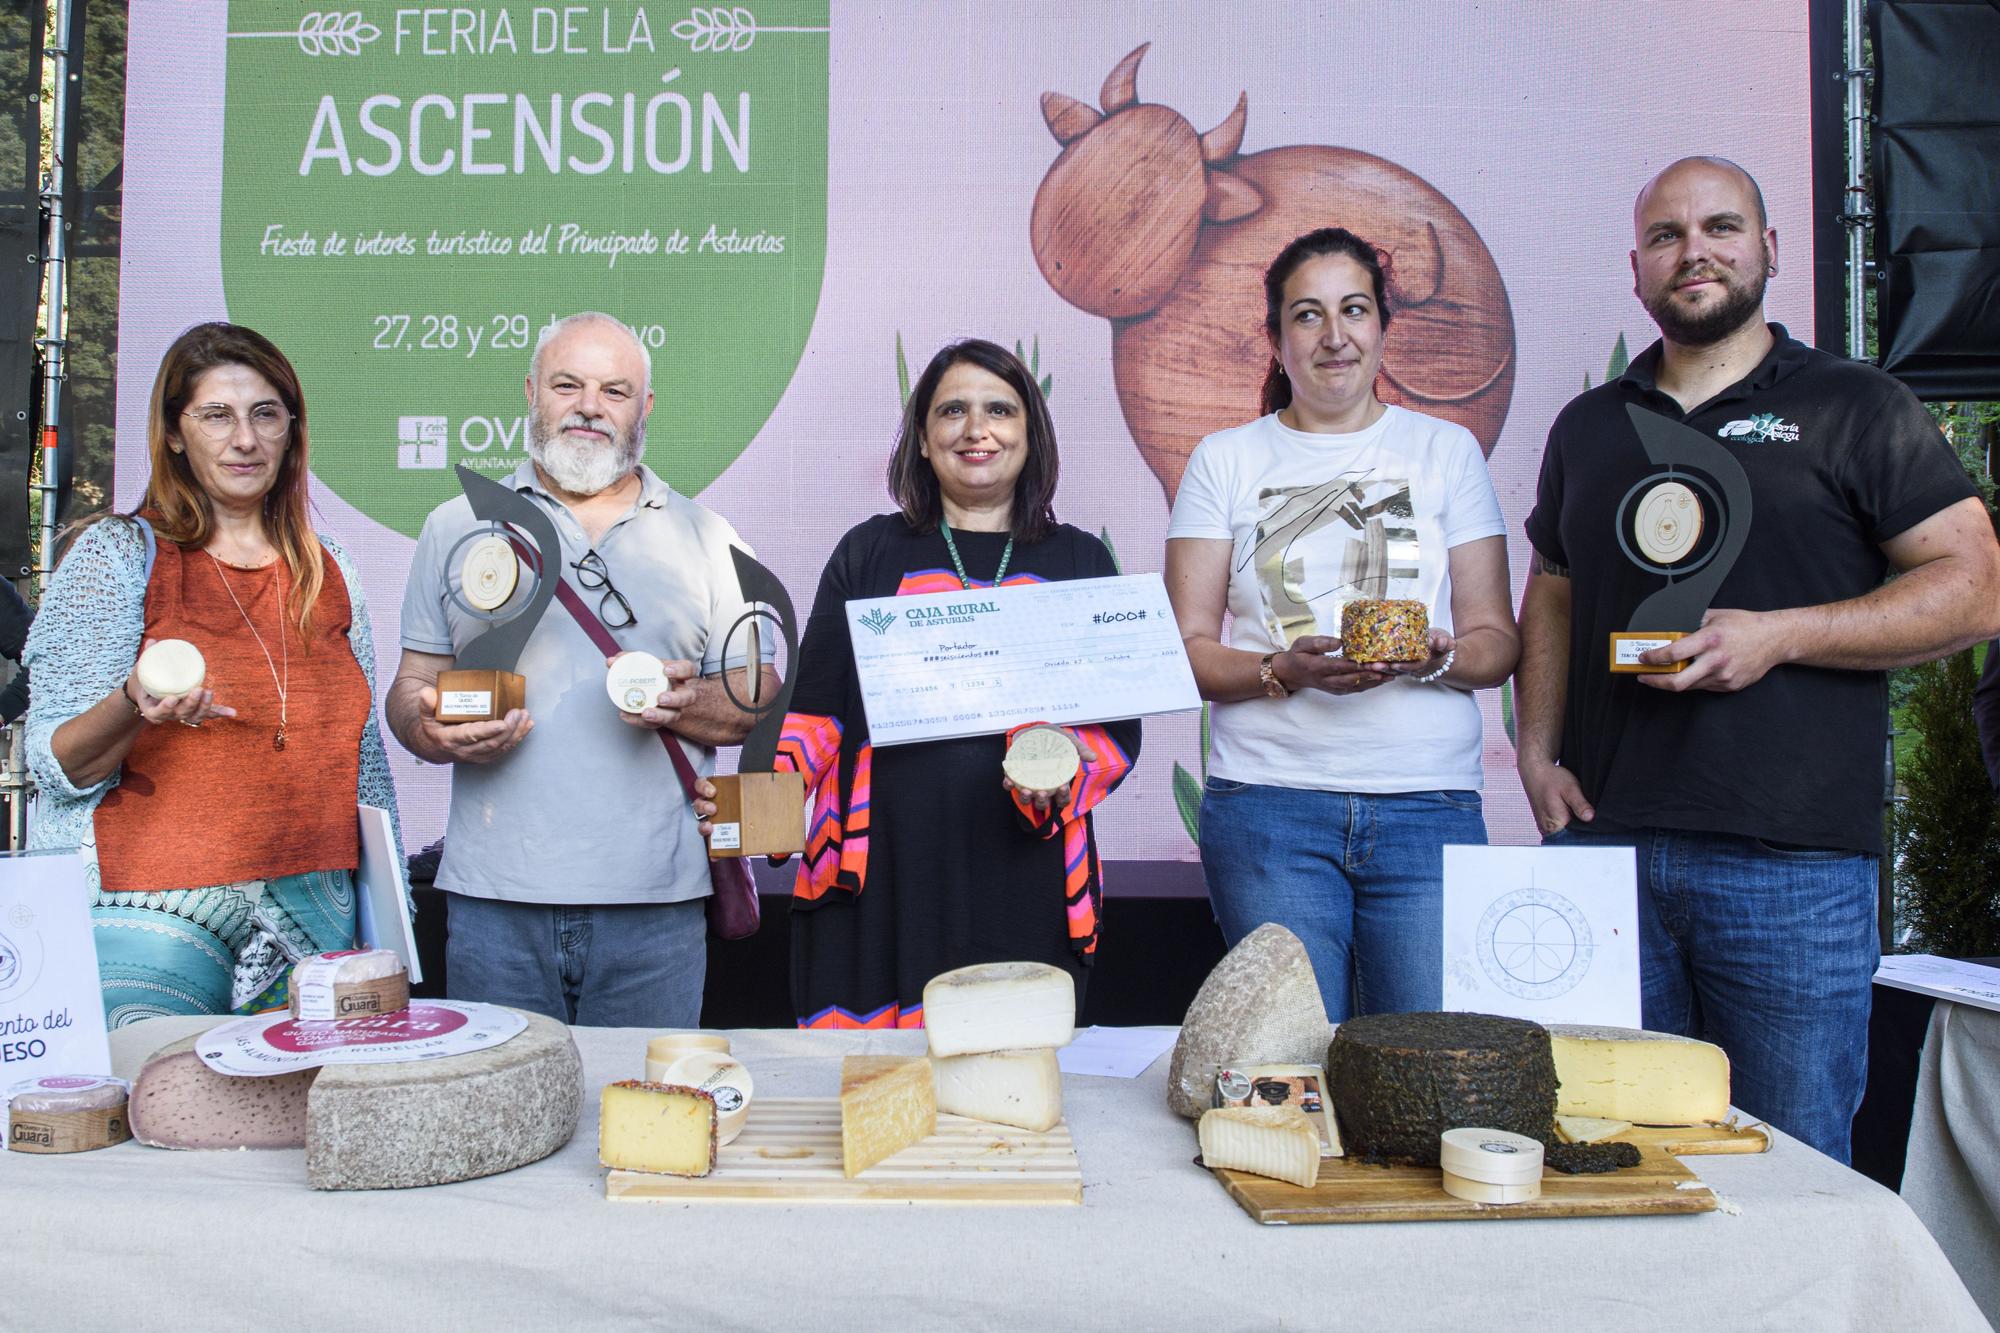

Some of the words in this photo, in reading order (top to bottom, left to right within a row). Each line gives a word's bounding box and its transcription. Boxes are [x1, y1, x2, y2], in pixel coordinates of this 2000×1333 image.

[395, 7, 518, 56] FERIA
[532, 7, 589, 54] DE
[602, 6, 656, 53] LA
[298, 68, 751, 177] ASCENSIÓN
[260, 223, 317, 257] Fiesta
[322, 231, 347, 257] de
[427, 229, 513, 256] turístico
[519, 223, 553, 255] del
[557, 223, 659, 270] Principado
[665, 229, 689, 255] de
[698, 223, 785, 254] Asturias
[373, 314, 412, 352] 27,
[420, 314, 459, 349] 28
[466, 325, 485, 359] y
[491, 314, 530, 349] 29
[459, 415, 529, 453] OVI
[905, 606, 944, 620] CAJA
[946, 601, 1001, 617] RURAL
[909, 619, 924, 628] DE
[926, 615, 976, 627] ASTURIAS
[939, 641, 977, 652] Portador
[341, 996, 378, 1013] Guara
[43, 1007, 73, 1031] del
[12, 1123, 50, 1143] Guara
